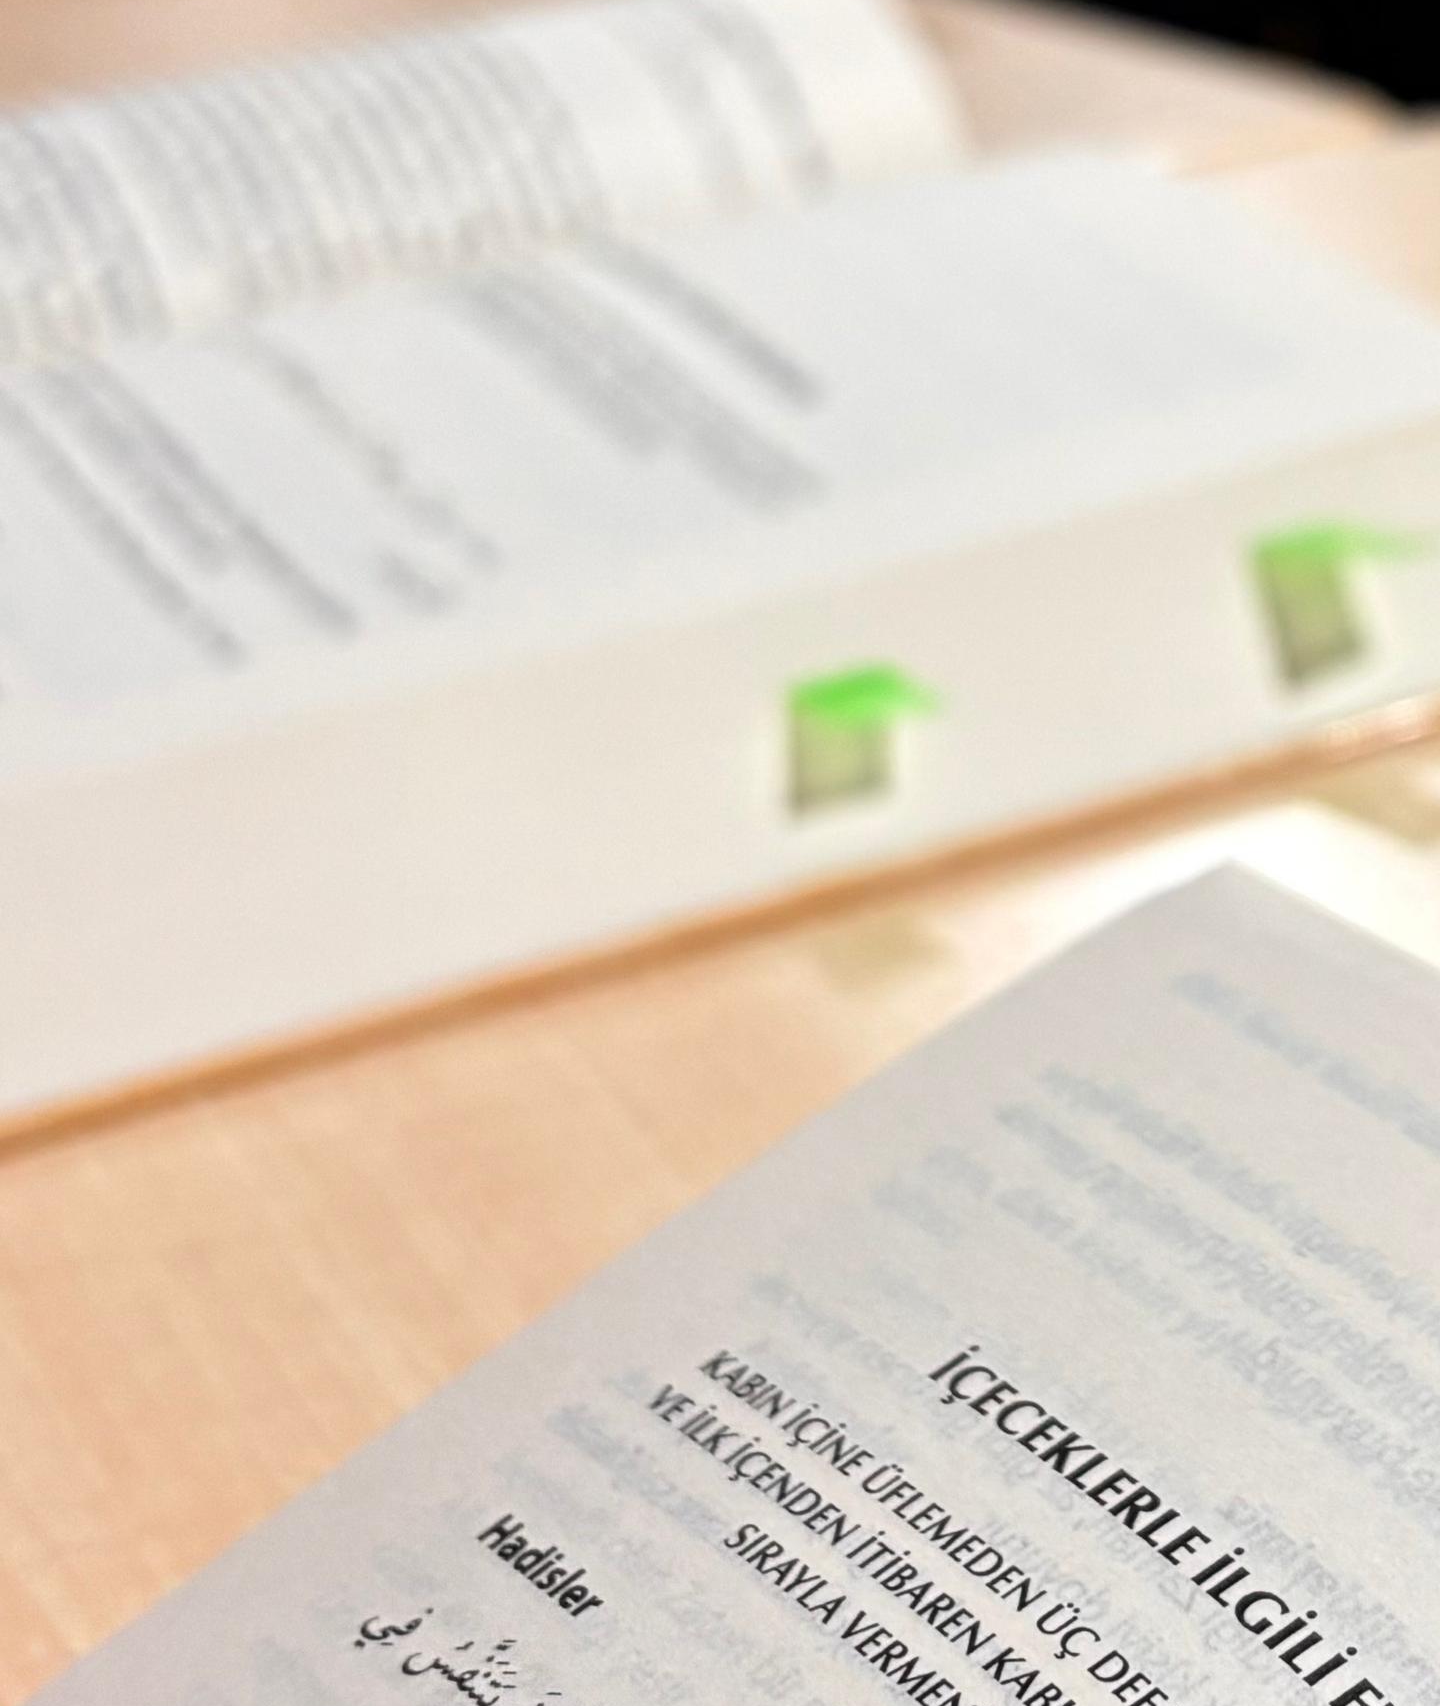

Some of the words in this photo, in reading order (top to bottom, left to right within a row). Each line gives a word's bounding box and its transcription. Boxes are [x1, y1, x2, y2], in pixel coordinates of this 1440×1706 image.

[478, 1514, 604, 1617] Hadisler
[649, 1384, 693, 1422] VE
[679, 1404, 739, 1454] İLK
[723, 1437, 860, 1546] İÇENDEN
[847, 1530, 996, 1655] İTİBAREN
[700, 1350, 795, 1419] KABIN
[786, 1403, 873, 1477] İÇİNE
[862, 1464, 1045, 1612] ÜFLEMEDEN
[1037, 1601, 1101, 1660] ÜÇ
[724, 1523, 847, 1625] SIRAYLA
[929, 1345, 1212, 1565] İÇECEKLERLE
[1191, 1530, 1357, 1687] İLGİLİ
